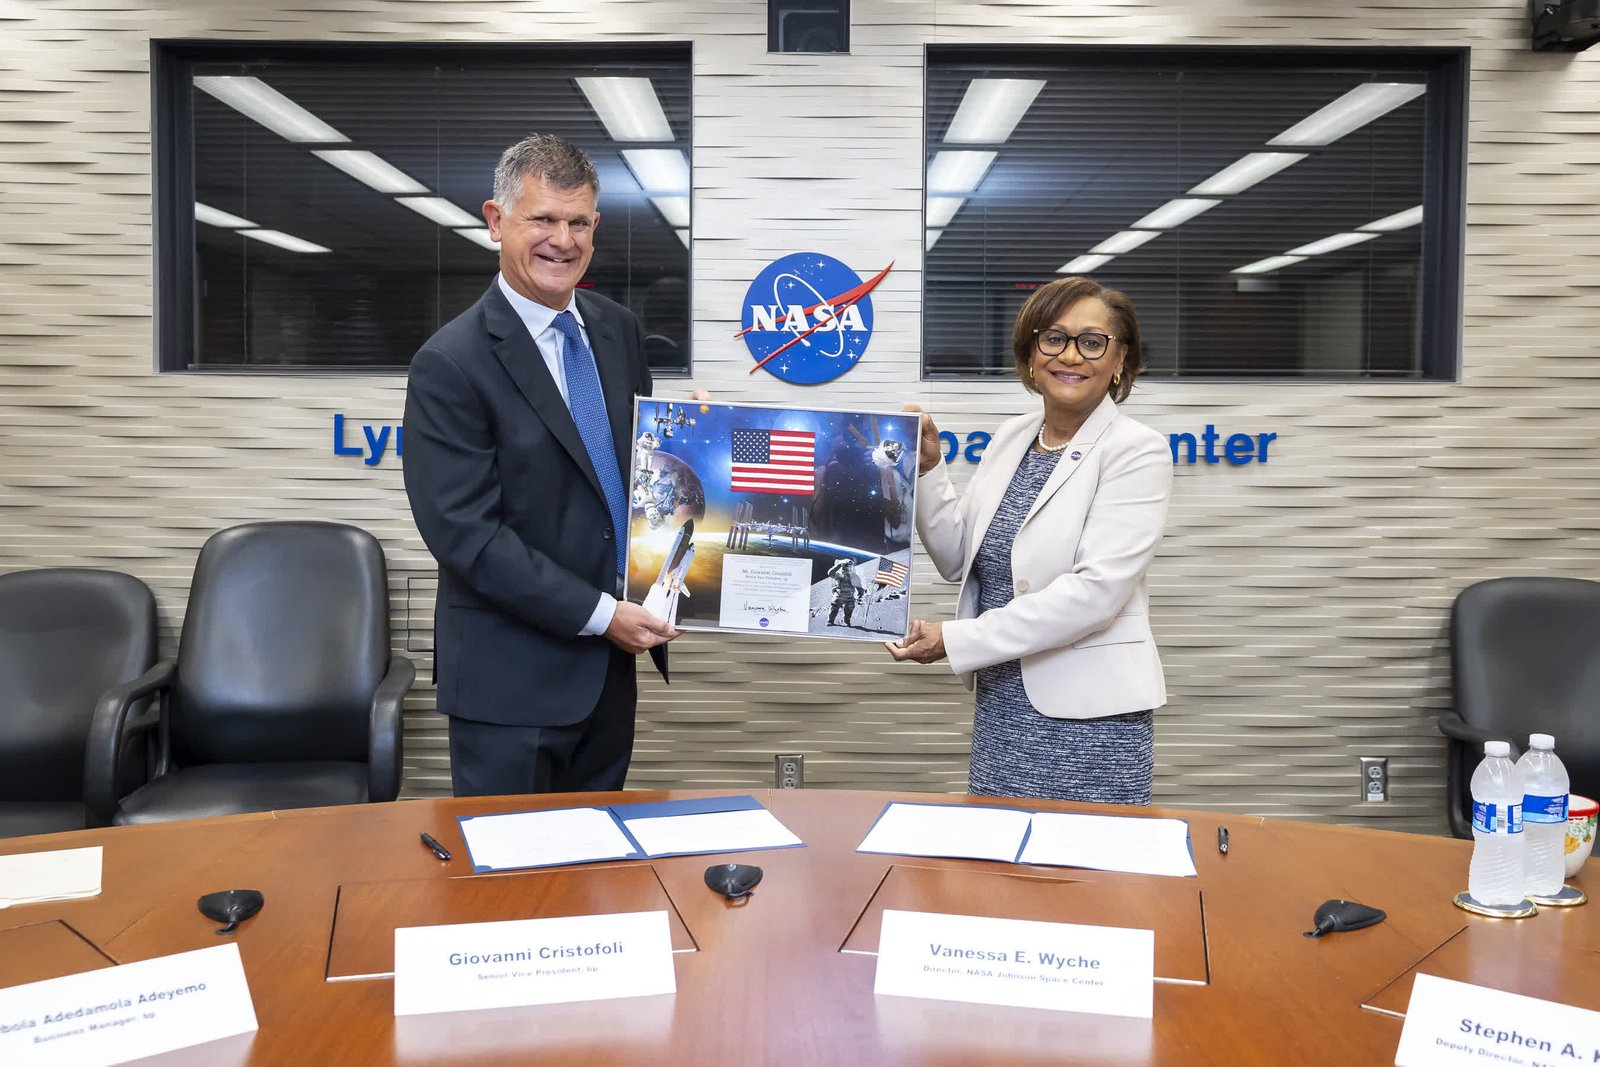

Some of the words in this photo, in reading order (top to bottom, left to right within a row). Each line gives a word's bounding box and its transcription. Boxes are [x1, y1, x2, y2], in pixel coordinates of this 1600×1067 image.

[750, 304, 868, 332] NASA
[1169, 424, 1277, 465] nter
[449, 948, 532, 966] Giovanni
[539, 941, 624, 959] Cristofoli
[929, 943, 1008, 962] Vanessa
[1014, 950, 1031, 964] E.
[1038, 952, 1101, 970] Wyche
[477, 972, 508, 981] Senior
[512, 970, 533, 978] Vice
[586, 965, 598, 973] bp
[966, 968, 993, 978] NASA
[996, 971, 1036, 982] Johnson
[1039, 974, 1069, 985] Space
[1072, 977, 1104, 987] Center
[43, 997, 133, 1025] Adedamola
[138, 981, 207, 1005] Adeyemo
[32, 1027, 85, 1044] Business
[1435, 1037, 1474, 1054] Deputy
[1459, 1018, 1552, 1052] Stephen
[1560, 1043, 1583, 1060] A.
